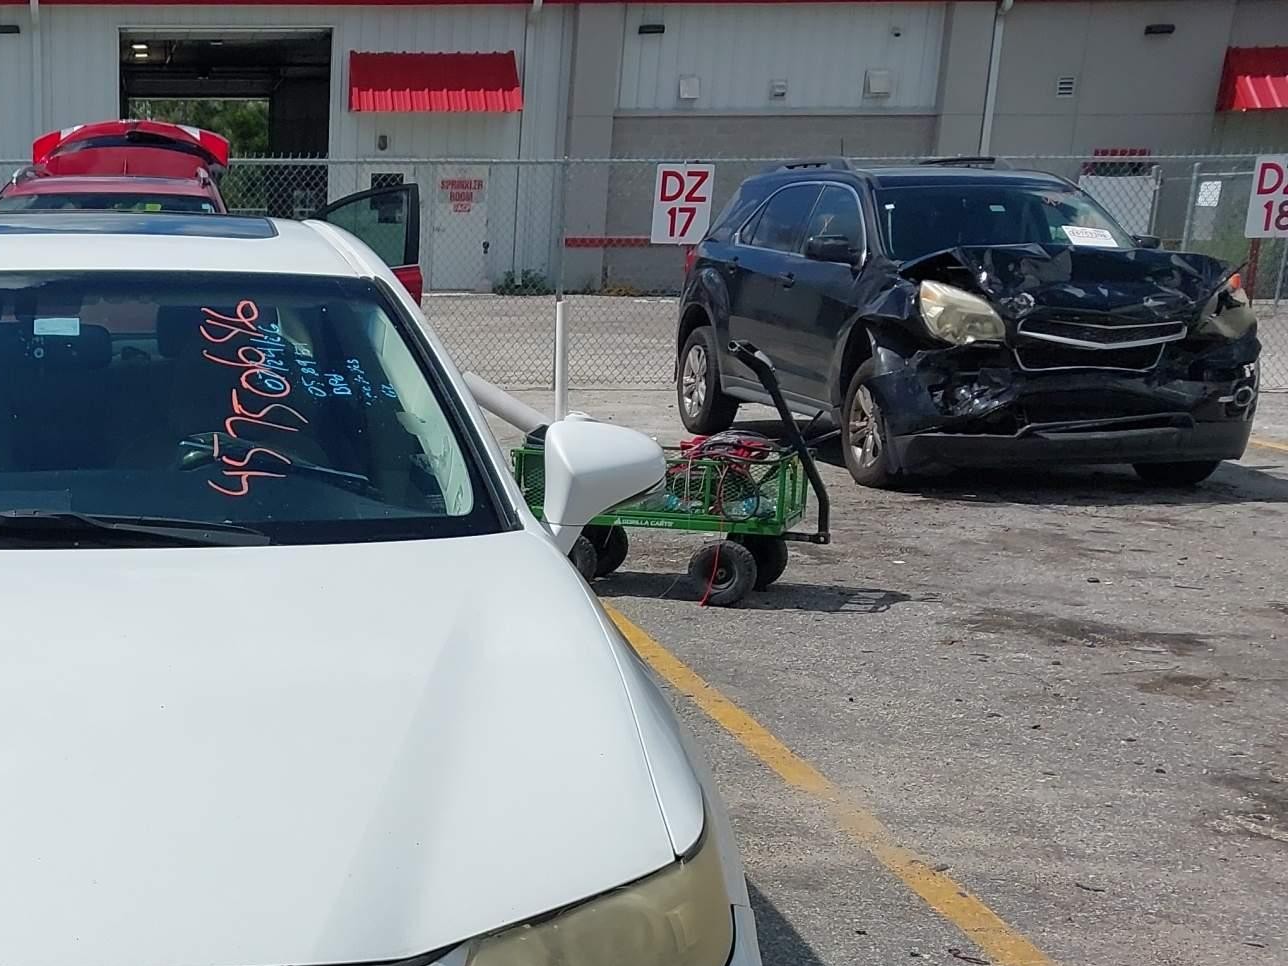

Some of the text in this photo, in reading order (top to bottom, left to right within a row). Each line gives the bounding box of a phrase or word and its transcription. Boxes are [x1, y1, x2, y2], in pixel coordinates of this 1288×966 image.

[660, 170, 709, 202] DZ
[1257, 163, 1288, 195] D
[667, 207, 696, 237] 17
[200, 300, 308, 496] 45750646
